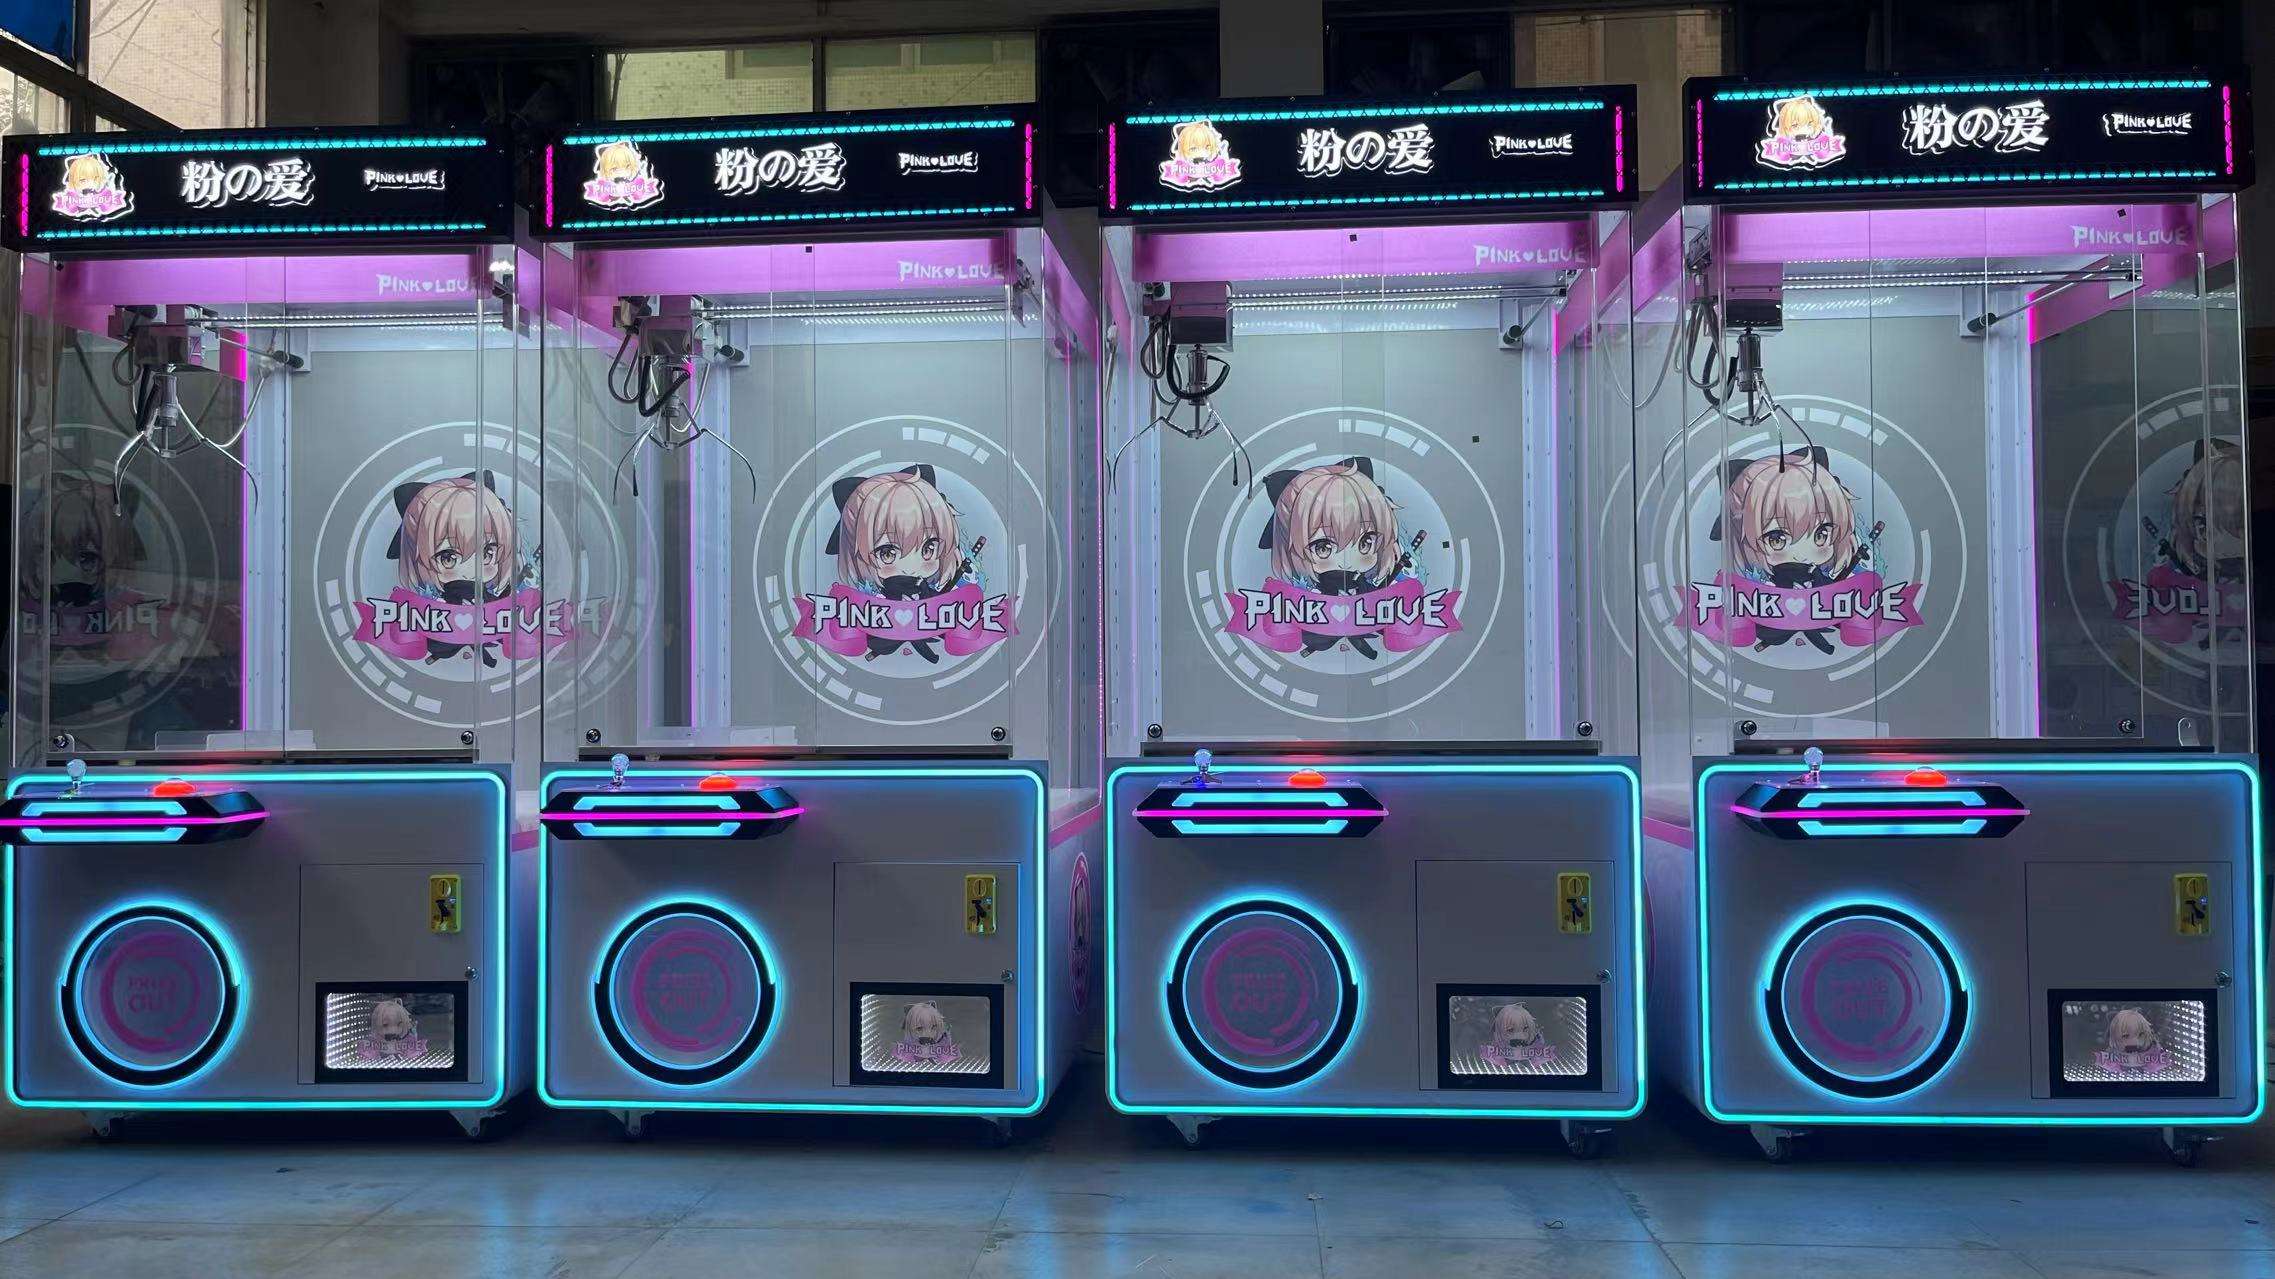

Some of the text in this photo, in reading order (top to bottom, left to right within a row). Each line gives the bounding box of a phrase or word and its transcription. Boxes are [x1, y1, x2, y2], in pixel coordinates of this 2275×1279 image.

[1910, 99, 2049, 150] 粉の爱
[2111, 112, 2192, 129] PINK LOVE
[1299, 122, 1434, 172] 粉の爱
[1494, 133, 1573, 152] PINK LOVE
[715, 142, 843, 190] 粉の爱
[898, 151, 973, 169] PINK LOVE
[181, 158, 308, 202] 粉の爱
[364, 169, 438, 185] PINK LOVE
[2071, 225, 2191, 248] PINK LOVE
[1473, 244, 1588, 266] PINK LOVE
[898, 260, 1005, 282] PINK LOVE
[376, 273, 421, 296] PINK
[1238, 588, 1449, 631] PINK LOVE
[1810, 581, 1908, 622] LOVE
[367, 598, 453, 639] PINK
[806, 593, 1006, 634] PINK LOVE
[897, 1043, 959, 1056] PINK LOVE
[1522, 1046, 1551, 1058] LOVE
